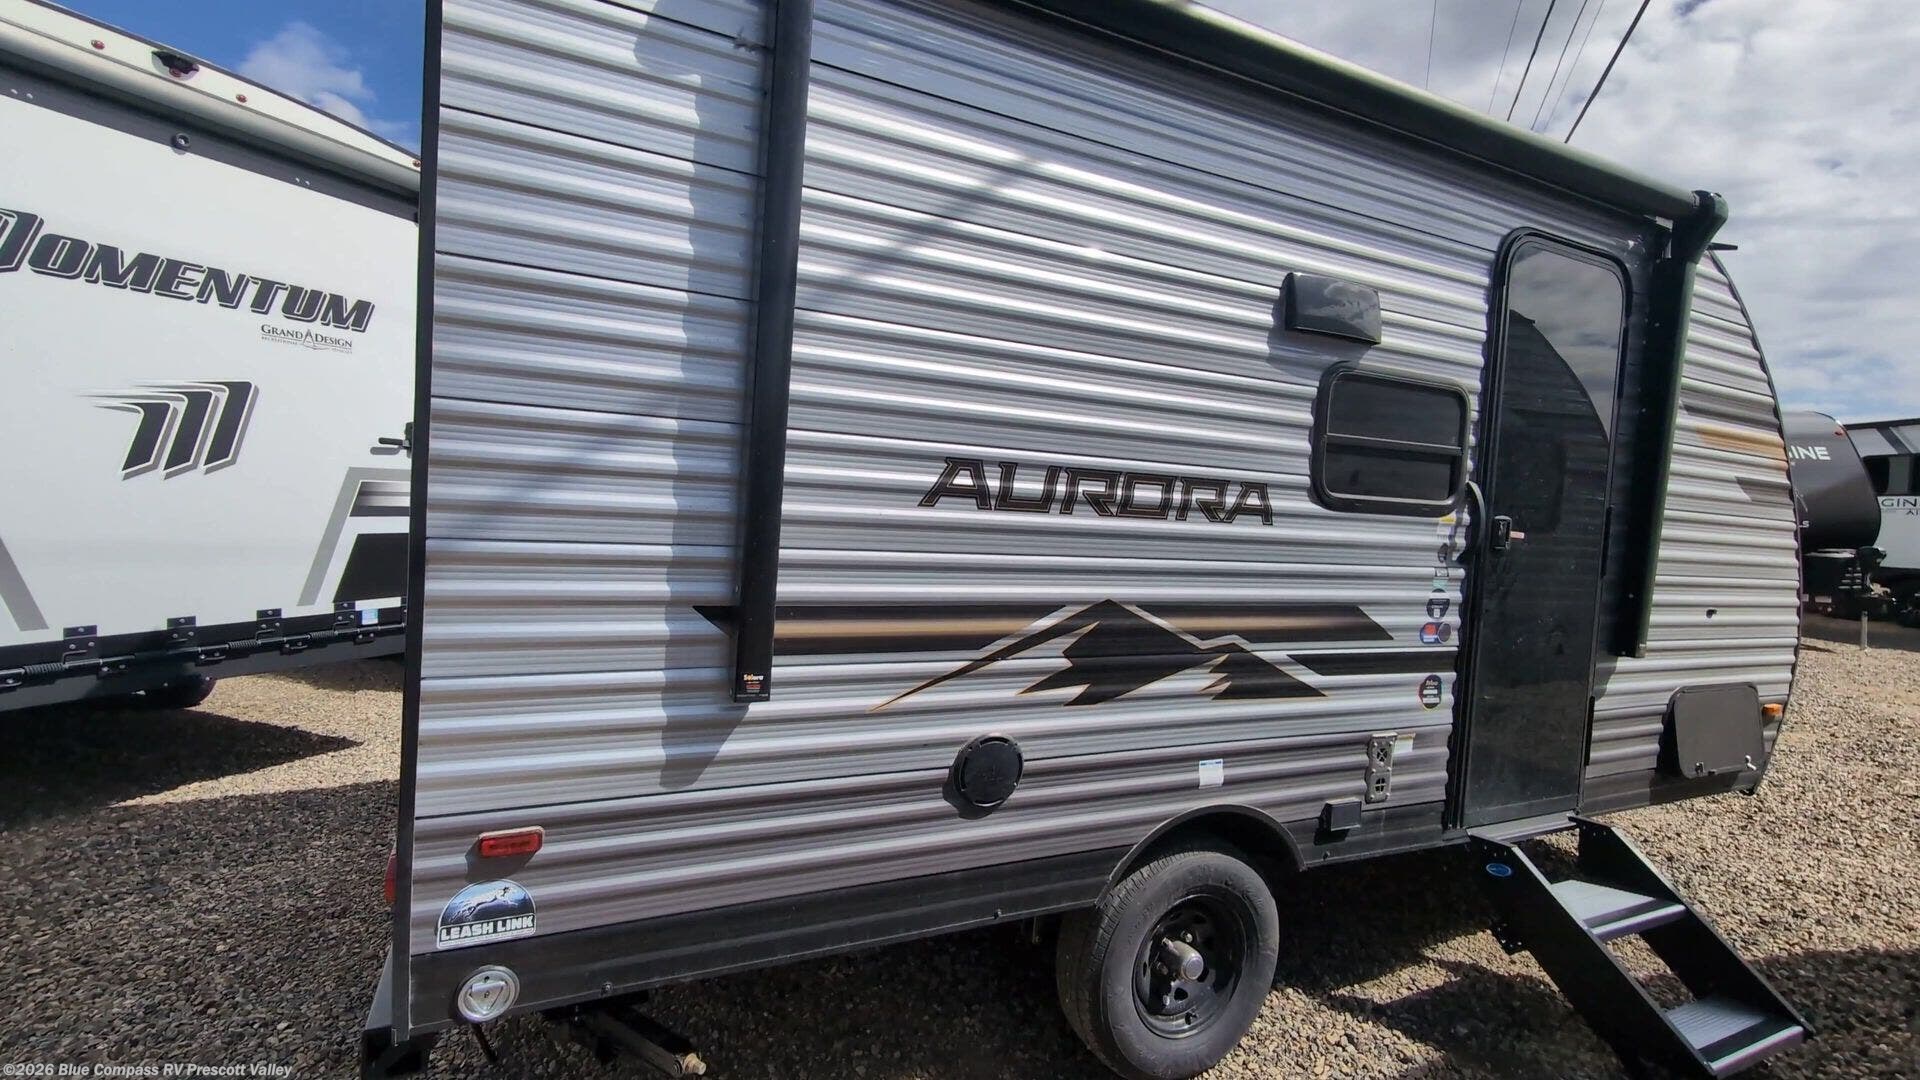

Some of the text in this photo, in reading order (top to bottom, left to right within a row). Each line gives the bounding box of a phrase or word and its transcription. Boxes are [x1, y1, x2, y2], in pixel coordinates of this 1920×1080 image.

[917, 457, 1274, 526] AURORA
[441, 922, 494, 941] LEASH
[497, 916, 533, 932] LINK
